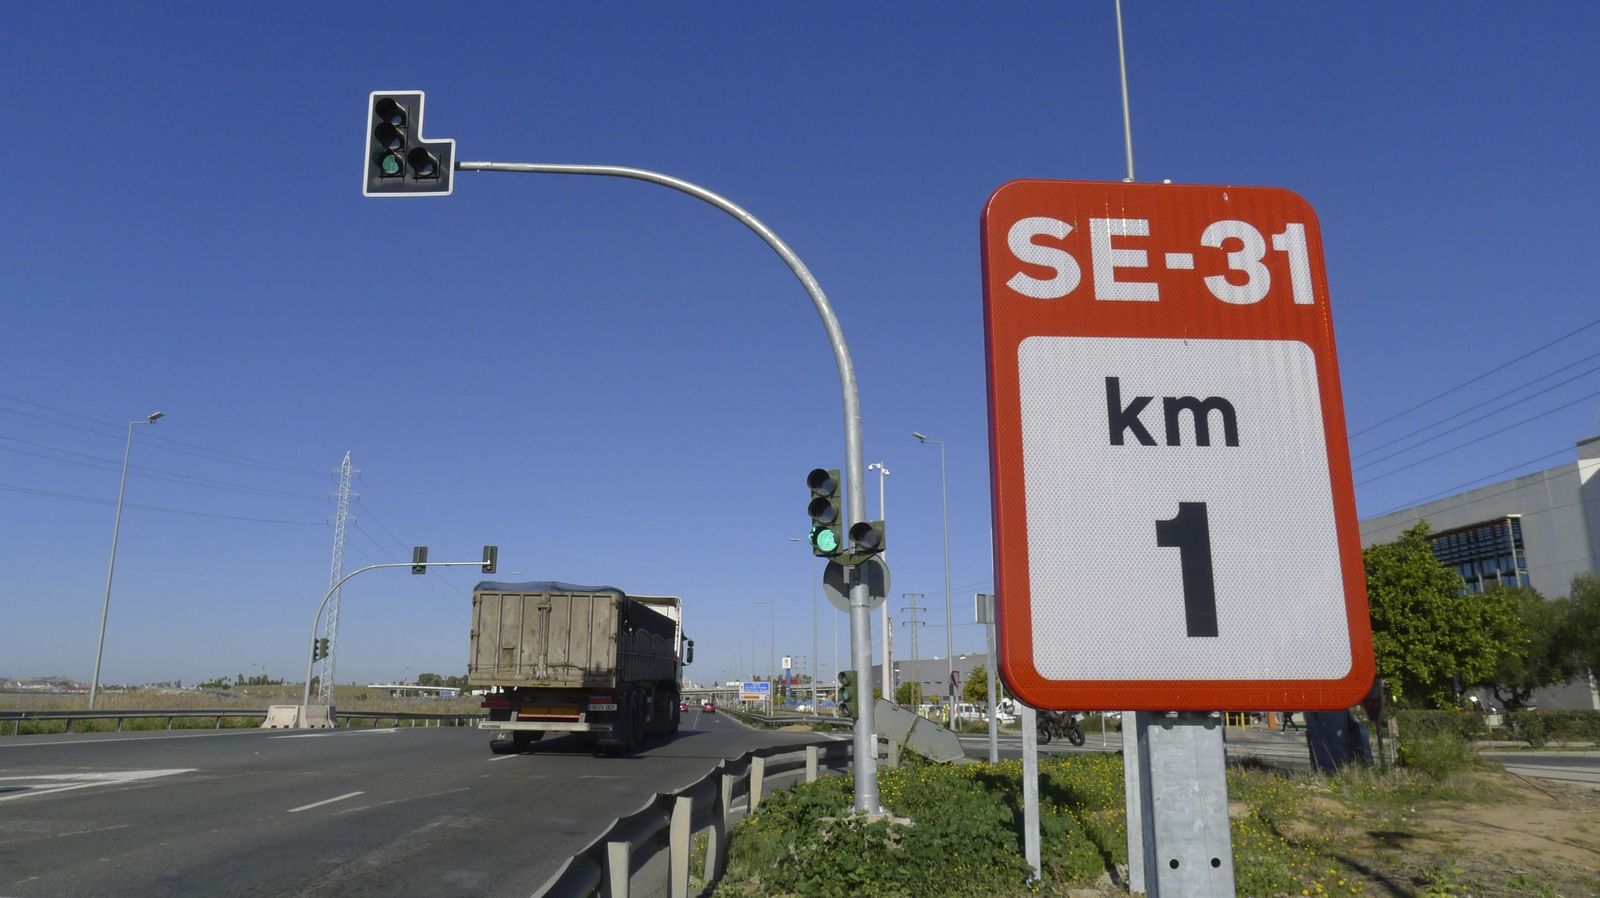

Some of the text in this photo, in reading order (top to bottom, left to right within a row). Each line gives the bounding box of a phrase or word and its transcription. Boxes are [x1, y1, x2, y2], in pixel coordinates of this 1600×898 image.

[1006, 216, 1315, 304] SE-31
[1105, 376, 1239, 447] km
[1155, 501, 1219, 637] 1
